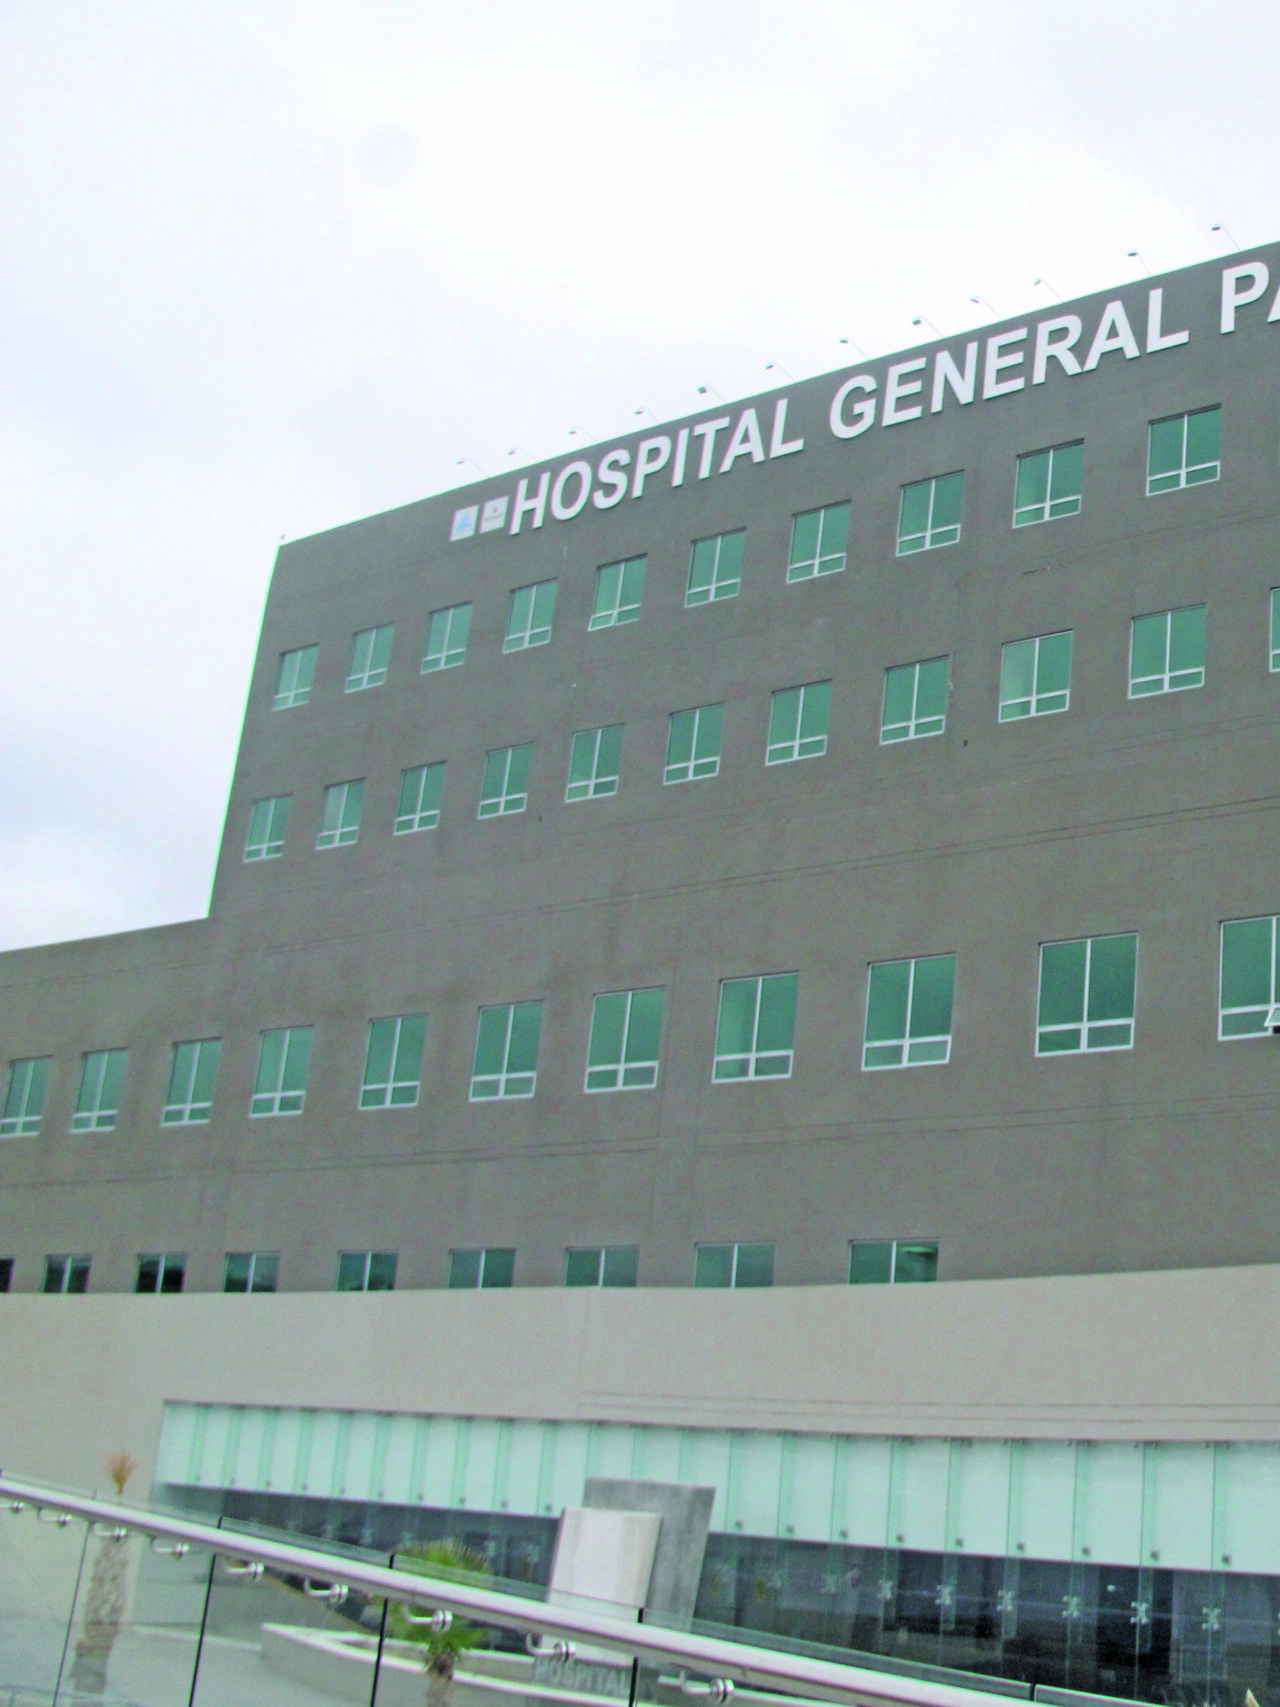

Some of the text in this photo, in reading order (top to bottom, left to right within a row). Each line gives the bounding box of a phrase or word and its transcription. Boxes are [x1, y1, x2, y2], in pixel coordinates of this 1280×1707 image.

[510, 398, 805, 535] HOSPITAL
[829, 287, 1190, 439] GENERAL
[534, 1658, 630, 1698] HOSPITAL
